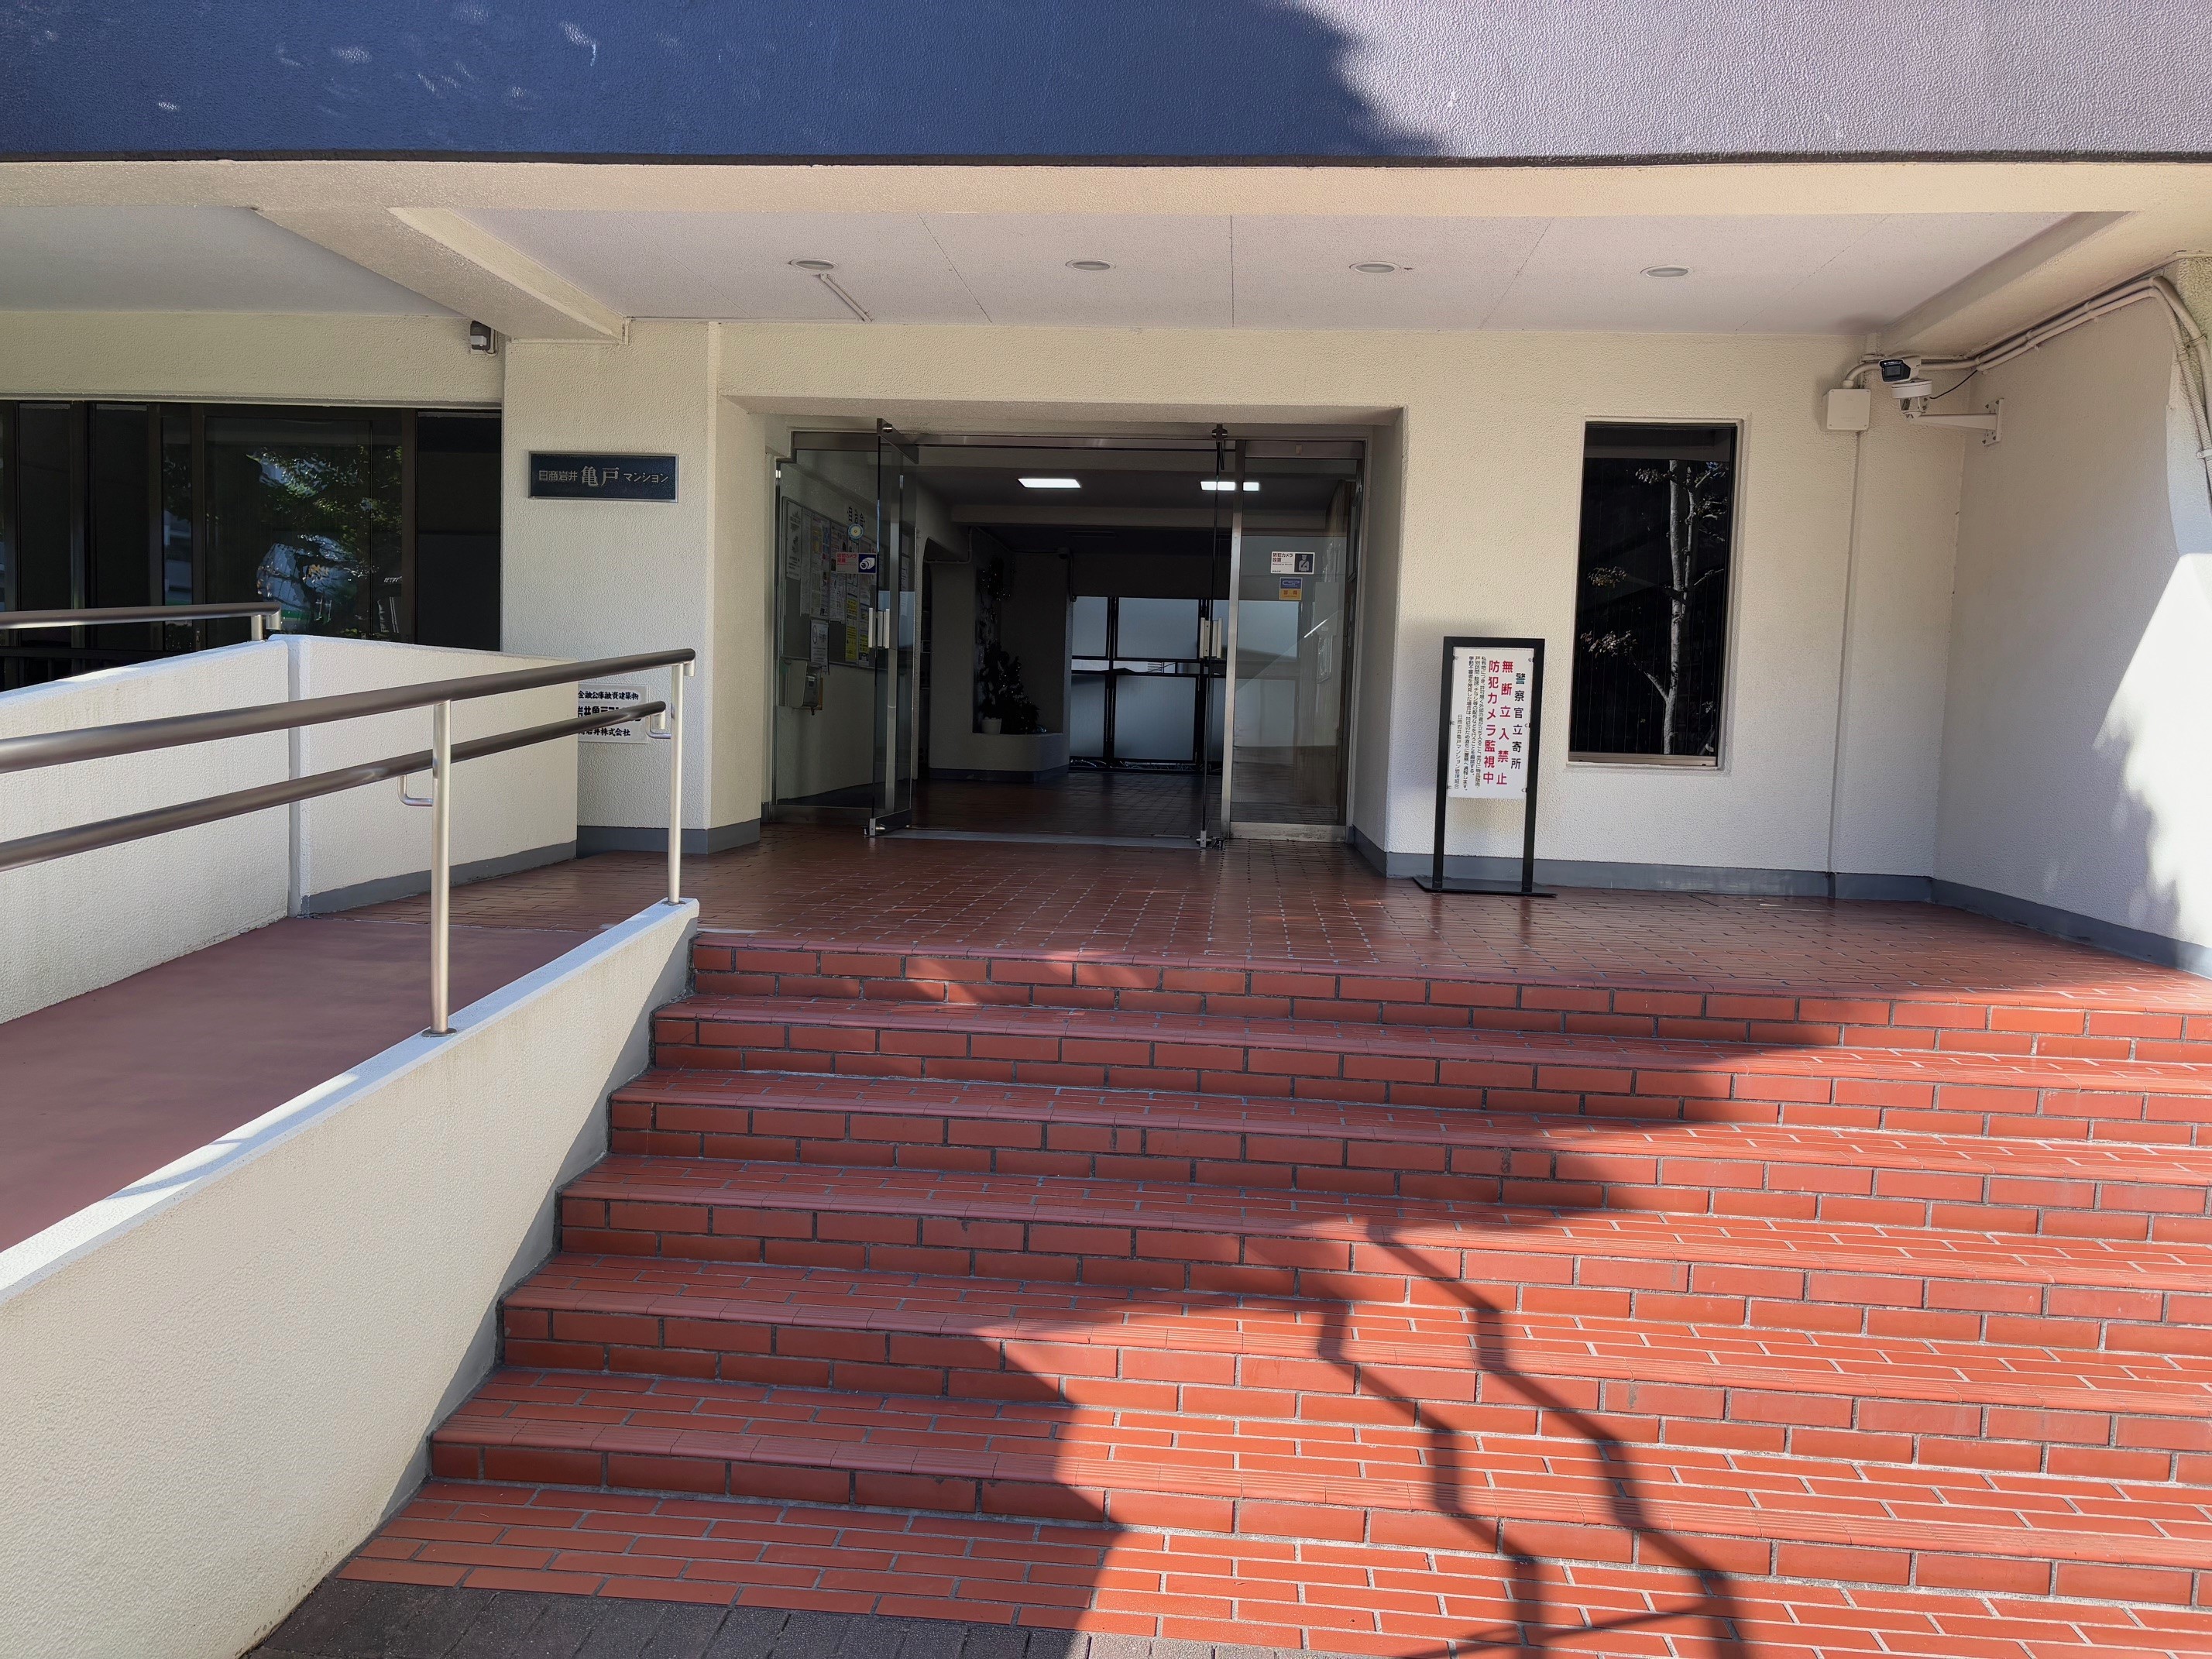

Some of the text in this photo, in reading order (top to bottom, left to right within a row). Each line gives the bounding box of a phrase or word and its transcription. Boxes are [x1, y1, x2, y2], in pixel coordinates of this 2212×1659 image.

[538, 465, 668, 487] 日商岩井亀戸マンション
[1482, 660, 1500, 785] 防犯カメラ監視中
[1496, 660, 1513, 785] 無断立入禁止
[1510, 672, 1526, 770] 警察官立寄所
